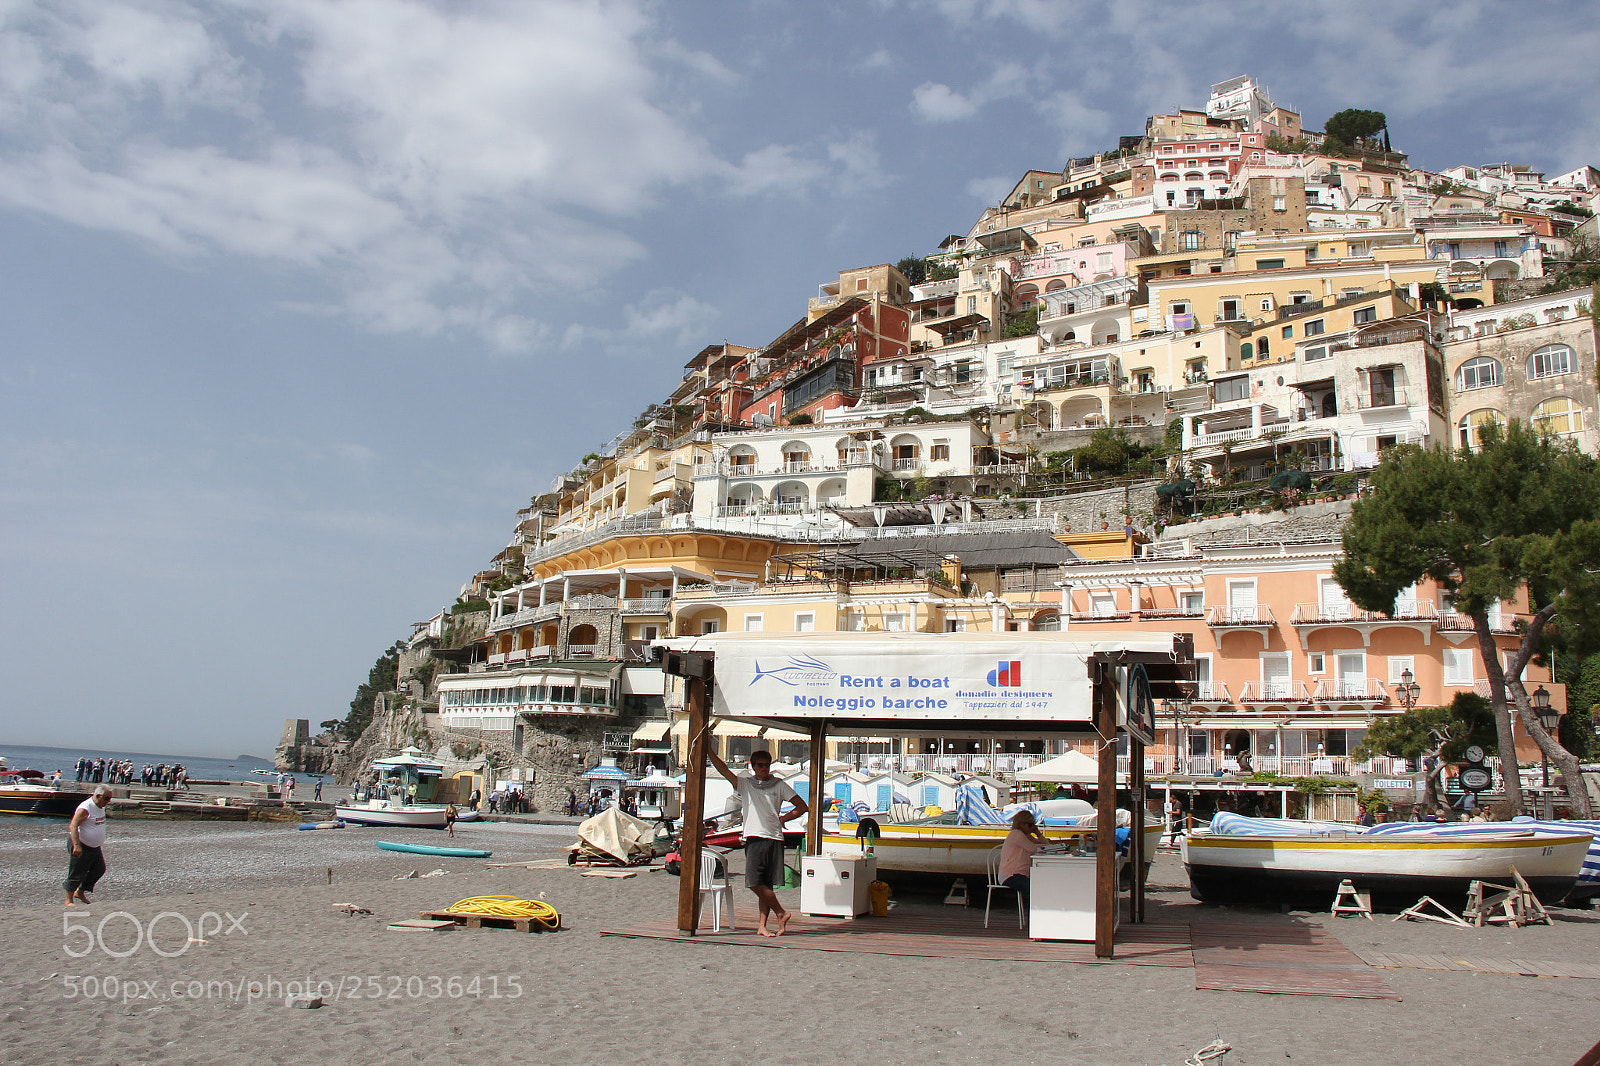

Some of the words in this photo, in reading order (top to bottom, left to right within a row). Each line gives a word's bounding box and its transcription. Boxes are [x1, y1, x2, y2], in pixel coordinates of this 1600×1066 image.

[783, 672, 838, 680] LUCIBELLO
[840, 675, 884, 688] Rent
[890, 677, 901, 688] a
[908, 675, 950, 688] boat
[955, 690, 997, 698] donadio
[1001, 690, 1053, 699] designers
[793, 695, 876, 711] Noleggio
[882, 696, 949, 709] barche
[963, 701, 1008, 710] Tappezzieri
[1375, 780, 1407, 788] TOILETTE
[1542, 846, 1554, 856] 16
